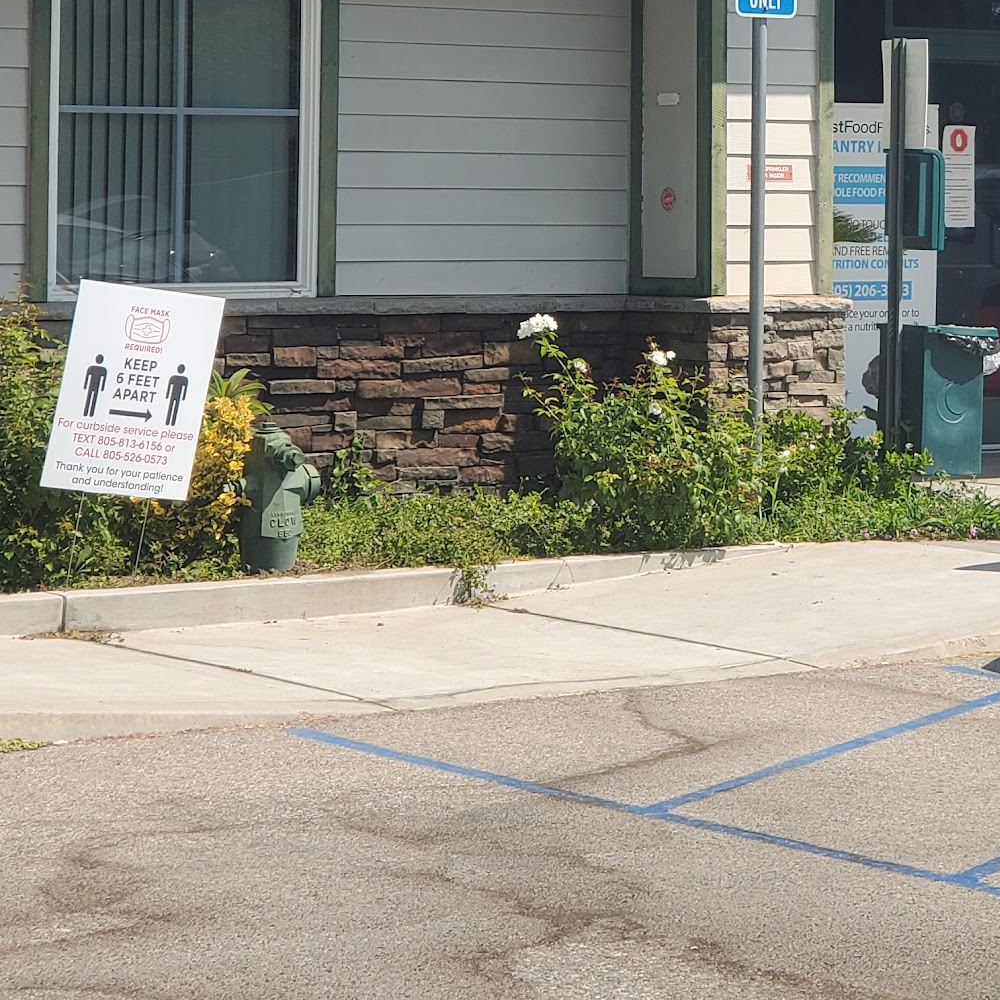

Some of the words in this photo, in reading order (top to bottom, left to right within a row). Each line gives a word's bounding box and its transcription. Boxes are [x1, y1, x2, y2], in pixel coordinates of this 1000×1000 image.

[833, 140, 874, 153] ANTRY
[838, 173, 887, 183] RECOMMEN
[834, 187, 851, 198] OLE
[852, 187, 877, 198] FOOD
[849, 246, 871, 256] FREE
[131, 306, 149, 315] FACE
[150, 308, 170, 317] MASK
[859, 310, 878, 320] your
[902, 310, 909, 318] or
[911, 309, 920, 318] to
[124, 343, 163, 354] REQUIRED!
[124, 357, 158, 372] KEEP
[116, 372, 125, 384] 6
[128, 373, 160, 388] FEET
[112, 387, 157, 403] APART
[57, 417, 74, 429] For
[76, 421, 121, 433] curbside
[123, 425, 158, 438] service
[160, 429, 194, 442] please
[73, 433, 96, 444] TEXT
[97, 435, 163, 451] 805-813-6156
[164, 444, 176, 453] or
[74, 447, 100, 459] CALL
[102, 450, 168, 465] 805-526-0573
[55, 461, 84, 472] Thank
[86, 466, 104, 475] you
[106, 465, 119, 476] for
[120, 468, 142, 479] your
[142, 469, 184, 482] patience
[71, 476, 92, 485] and
[93, 477, 164, 494] understanding!
